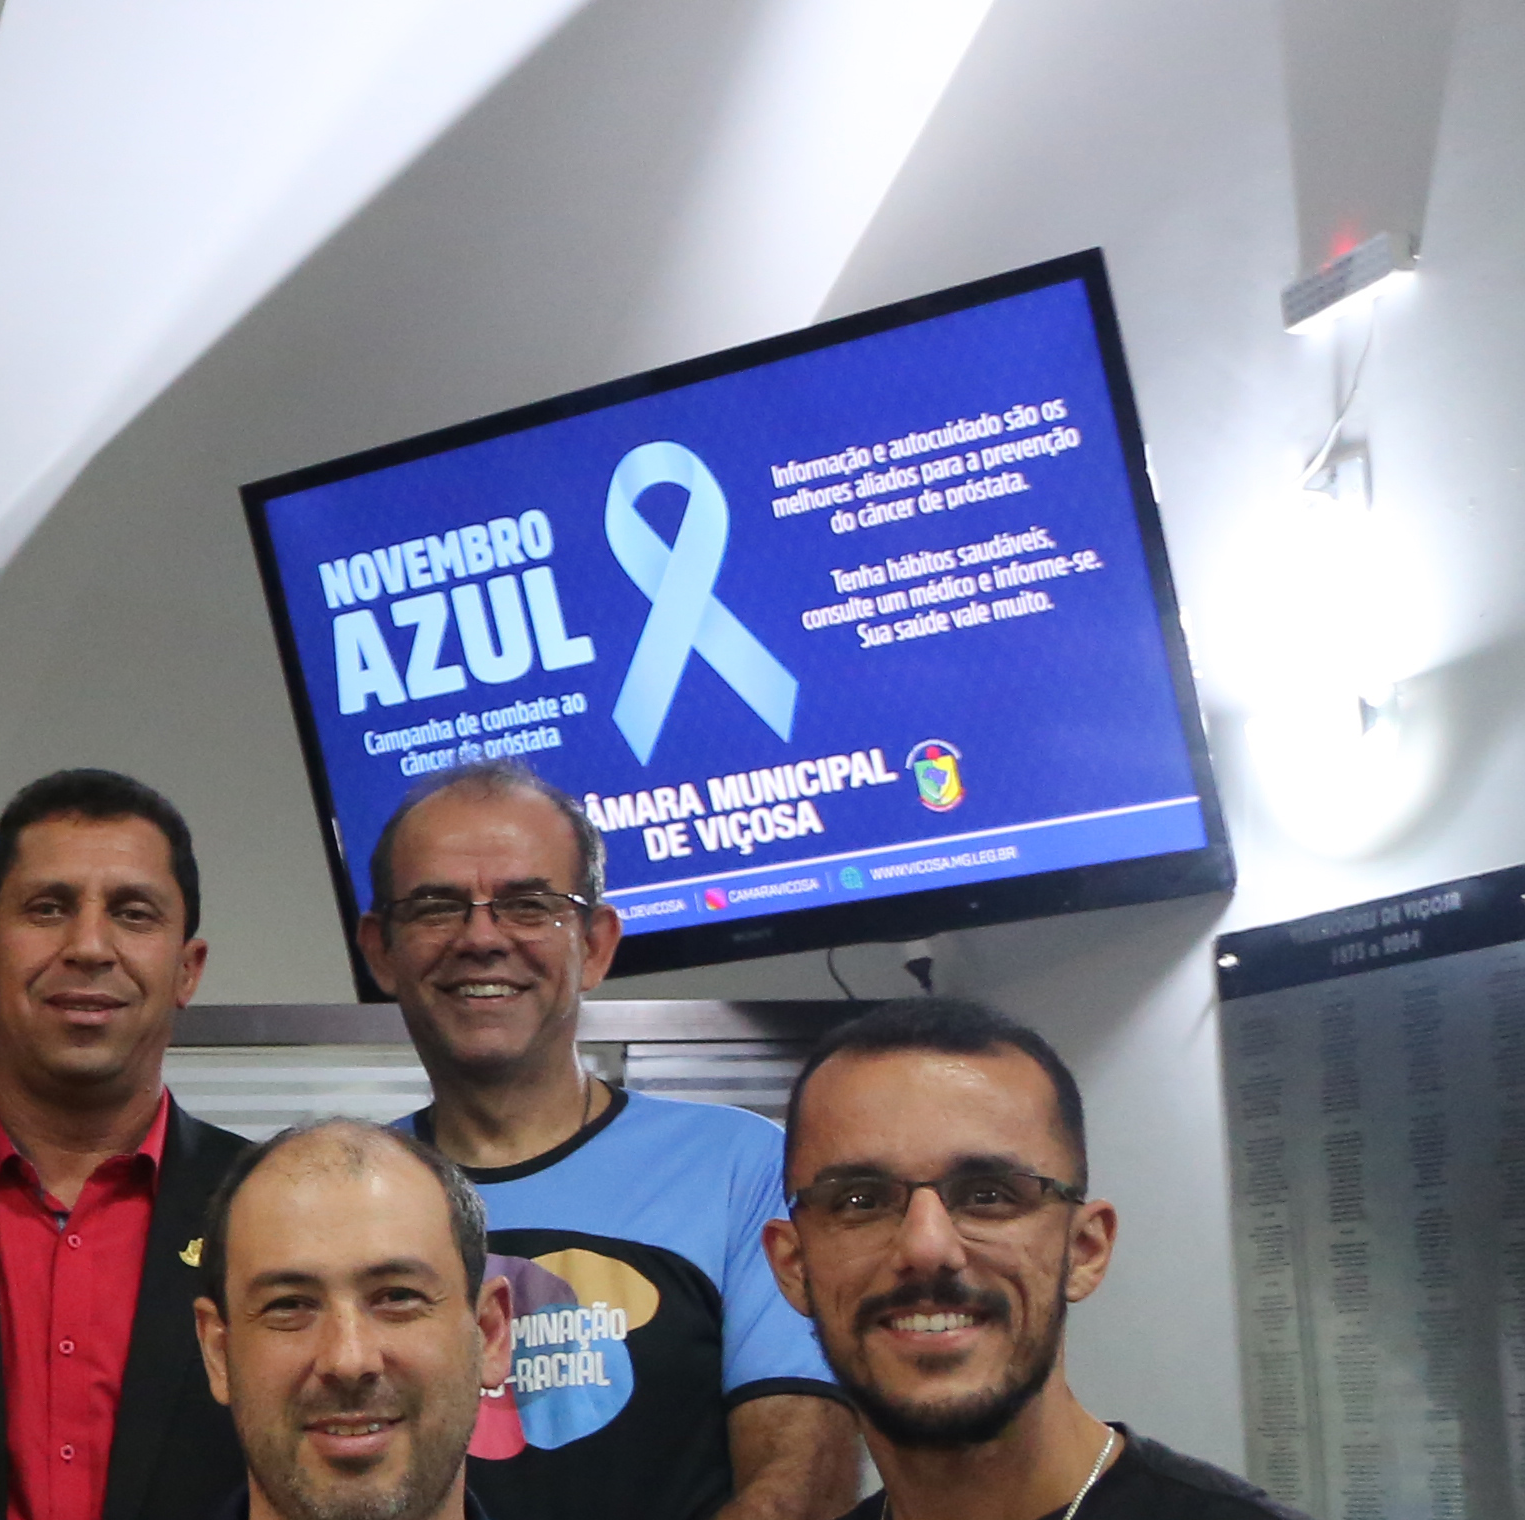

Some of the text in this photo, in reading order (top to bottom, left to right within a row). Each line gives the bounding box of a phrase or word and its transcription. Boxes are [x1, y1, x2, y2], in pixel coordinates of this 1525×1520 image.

[770, 398, 1067, 489] Informação e autocuidado são os
[772, 424, 1081, 519] melhores aliados para a prevenção
[830, 471, 1031, 535] do câncer de próstata.
[318, 509, 555, 609] NOVEMBRO
[802, 549, 1104, 630] consulte um médico e informe-se.
[830, 564, 886, 595] Tenha
[887, 549, 956, 583] hábitos
[333, 566, 595, 715] AZUL
[856, 590, 1055, 649] Sua saúde vale muito.
[364, 692, 587, 757] Campanha de combate ao
[400, 747, 456, 777] câncer
[485, 727, 561, 762] próstata
[583, 747, 899, 833] ÂMARA MUNICIPAL
[642, 799, 825, 861] DE VIÇOSA
[510, 1301, 627, 1351] MINAÇÃO
